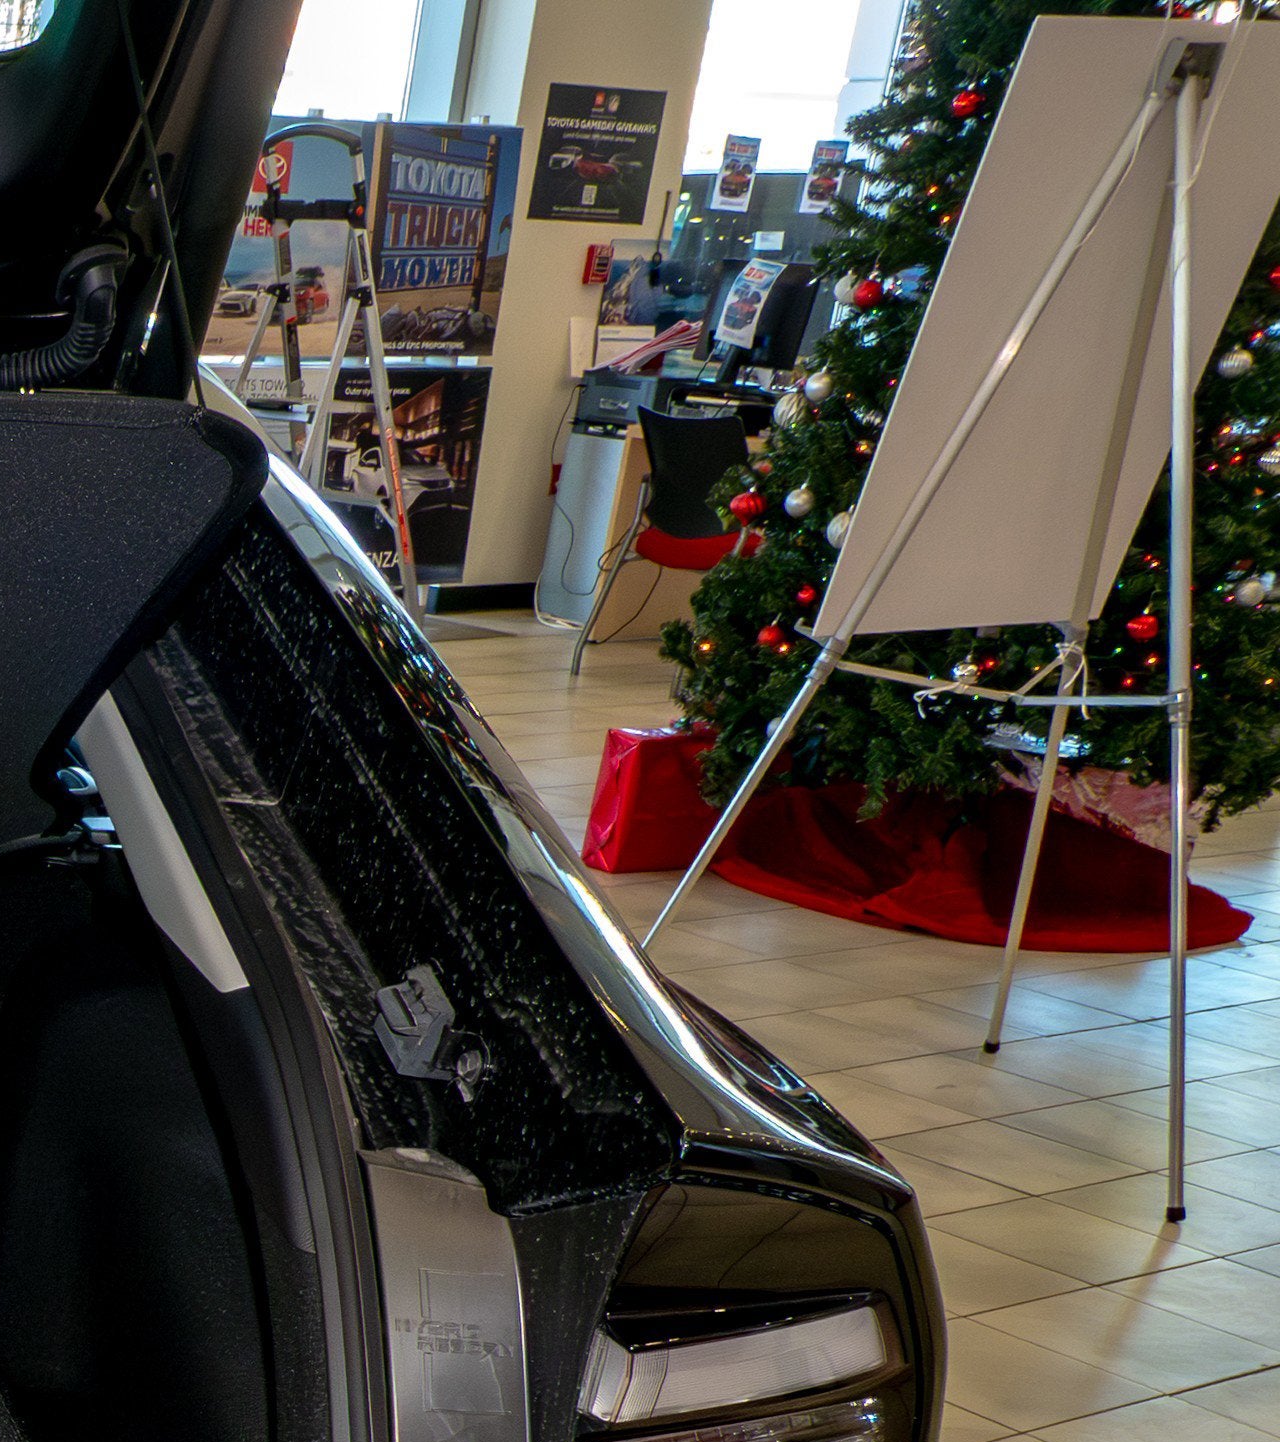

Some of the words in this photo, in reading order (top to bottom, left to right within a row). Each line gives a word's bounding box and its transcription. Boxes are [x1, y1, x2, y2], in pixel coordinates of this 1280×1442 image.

[547, 116, 580, 128] TOYOTA'S
[580, 119, 615, 131] GAMEDAY
[616, 122, 657, 134] GIVEAWAYS
[392, 153, 486, 199] TOYOTA
[387, 203, 482, 248] TRUCK
[380, 256, 475, 289] MONTH
